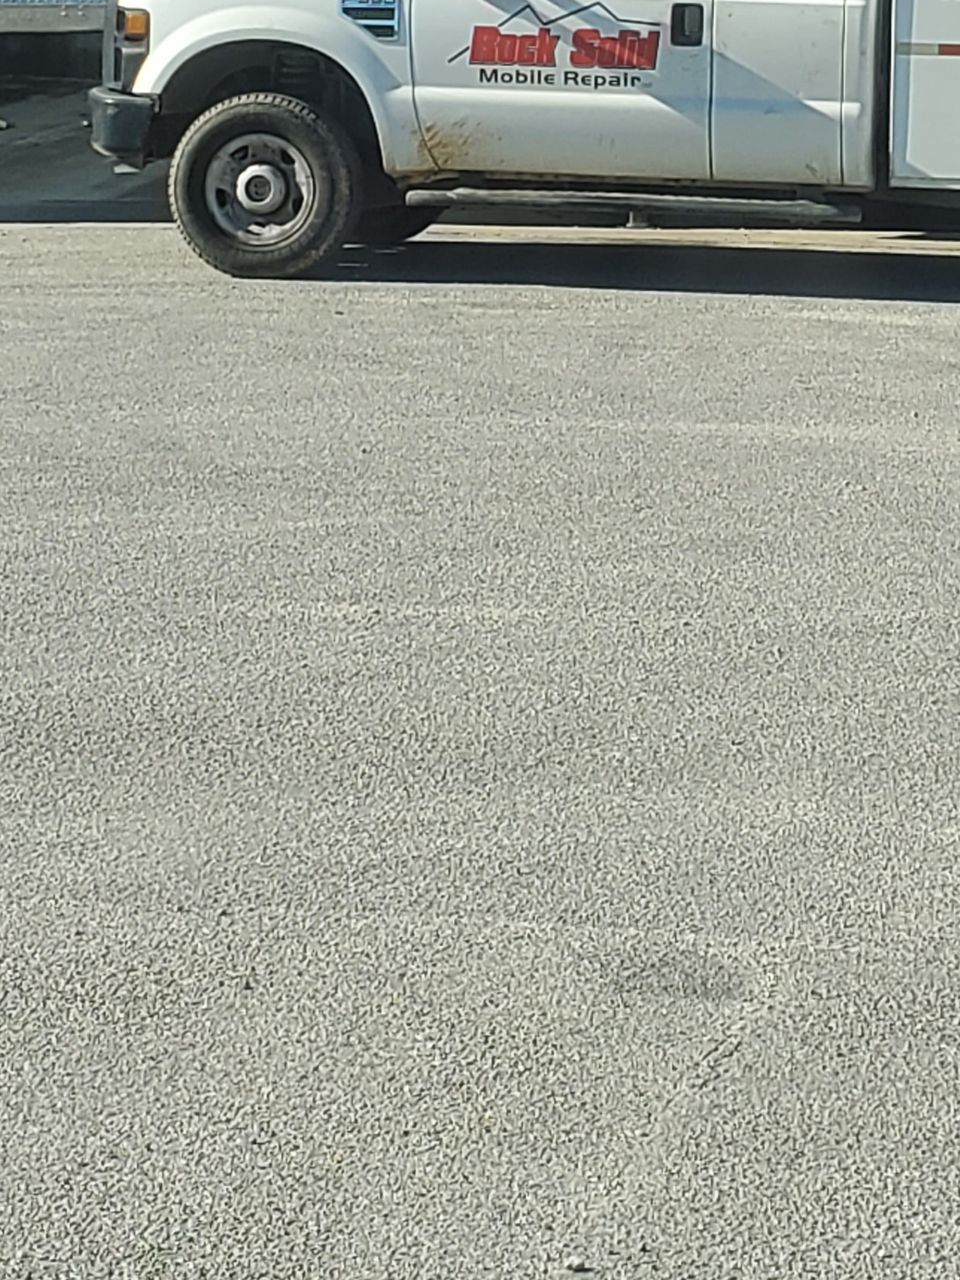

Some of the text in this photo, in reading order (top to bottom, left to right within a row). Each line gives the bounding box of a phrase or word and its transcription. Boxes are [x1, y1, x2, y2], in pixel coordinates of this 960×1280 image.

[469, 26, 660, 70] Rock Solid
[479, 69, 641, 89] Mobile Repair
